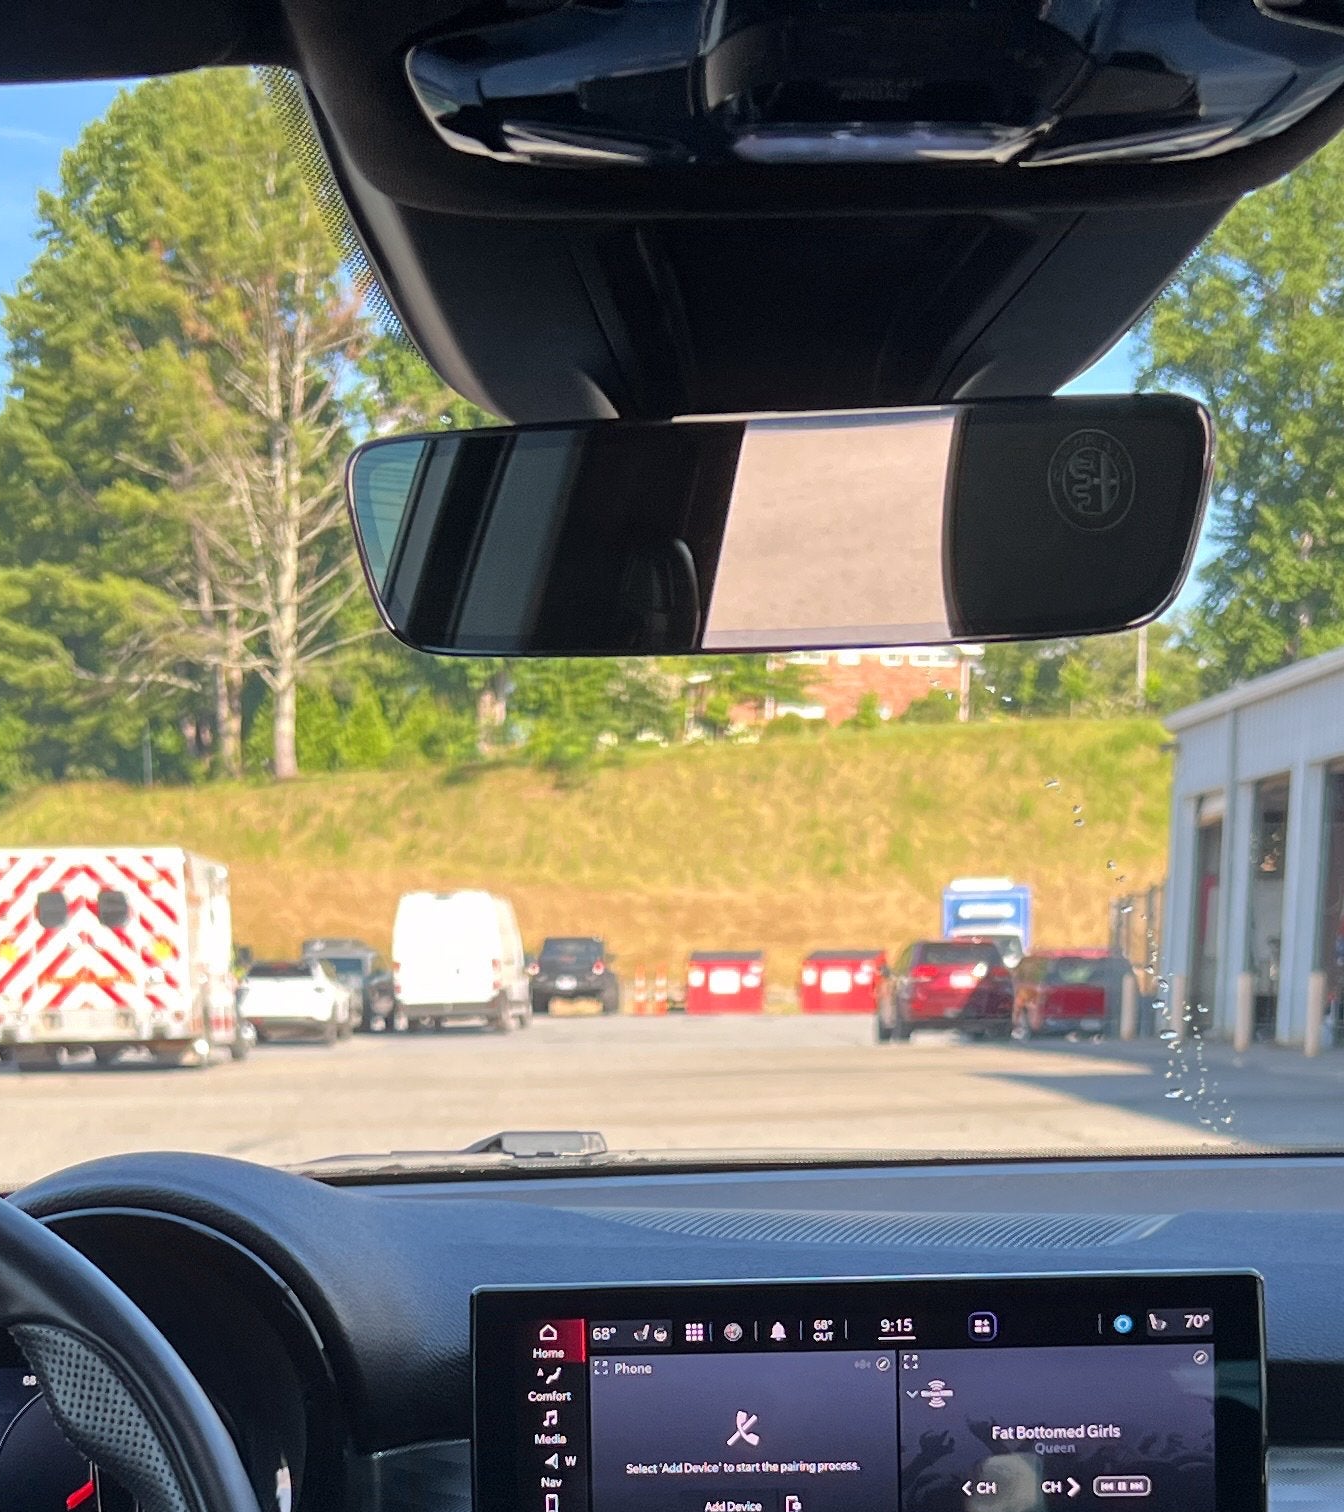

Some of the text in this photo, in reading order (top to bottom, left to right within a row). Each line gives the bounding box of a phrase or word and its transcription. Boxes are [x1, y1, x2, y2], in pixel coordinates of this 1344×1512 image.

[880, 1318, 913, 1333] 9:15
[1184, 1314, 1210, 1329] 70°
[812, 1331, 834, 1342] OUT
[532, 1347, 565, 1359] Home
[614, 1361, 652, 1375] Phone
[527, 1390, 572, 1402] Comfort
[992, 1423, 1120, 1440] Fat Bottomed Girls
[534, 1434, 567, 1445] Media
[1034, 1442, 1076, 1455] Queen
[564, 1455, 577, 1467] W
[625, 1463, 657, 1475] Select
[724, 1462, 734, 1473] to
[736, 1462, 760, 1473] start
[762, 1461, 779, 1472] the
[780, 1461, 815, 1474] pairing
[817, 1461, 860, 1474] process.
[540, 1477, 562, 1488] Nav
[976, 1481, 997, 1495] CH
[1041, 1481, 1062, 1494] CH
[704, 1500, 762, 1512] Add Device
